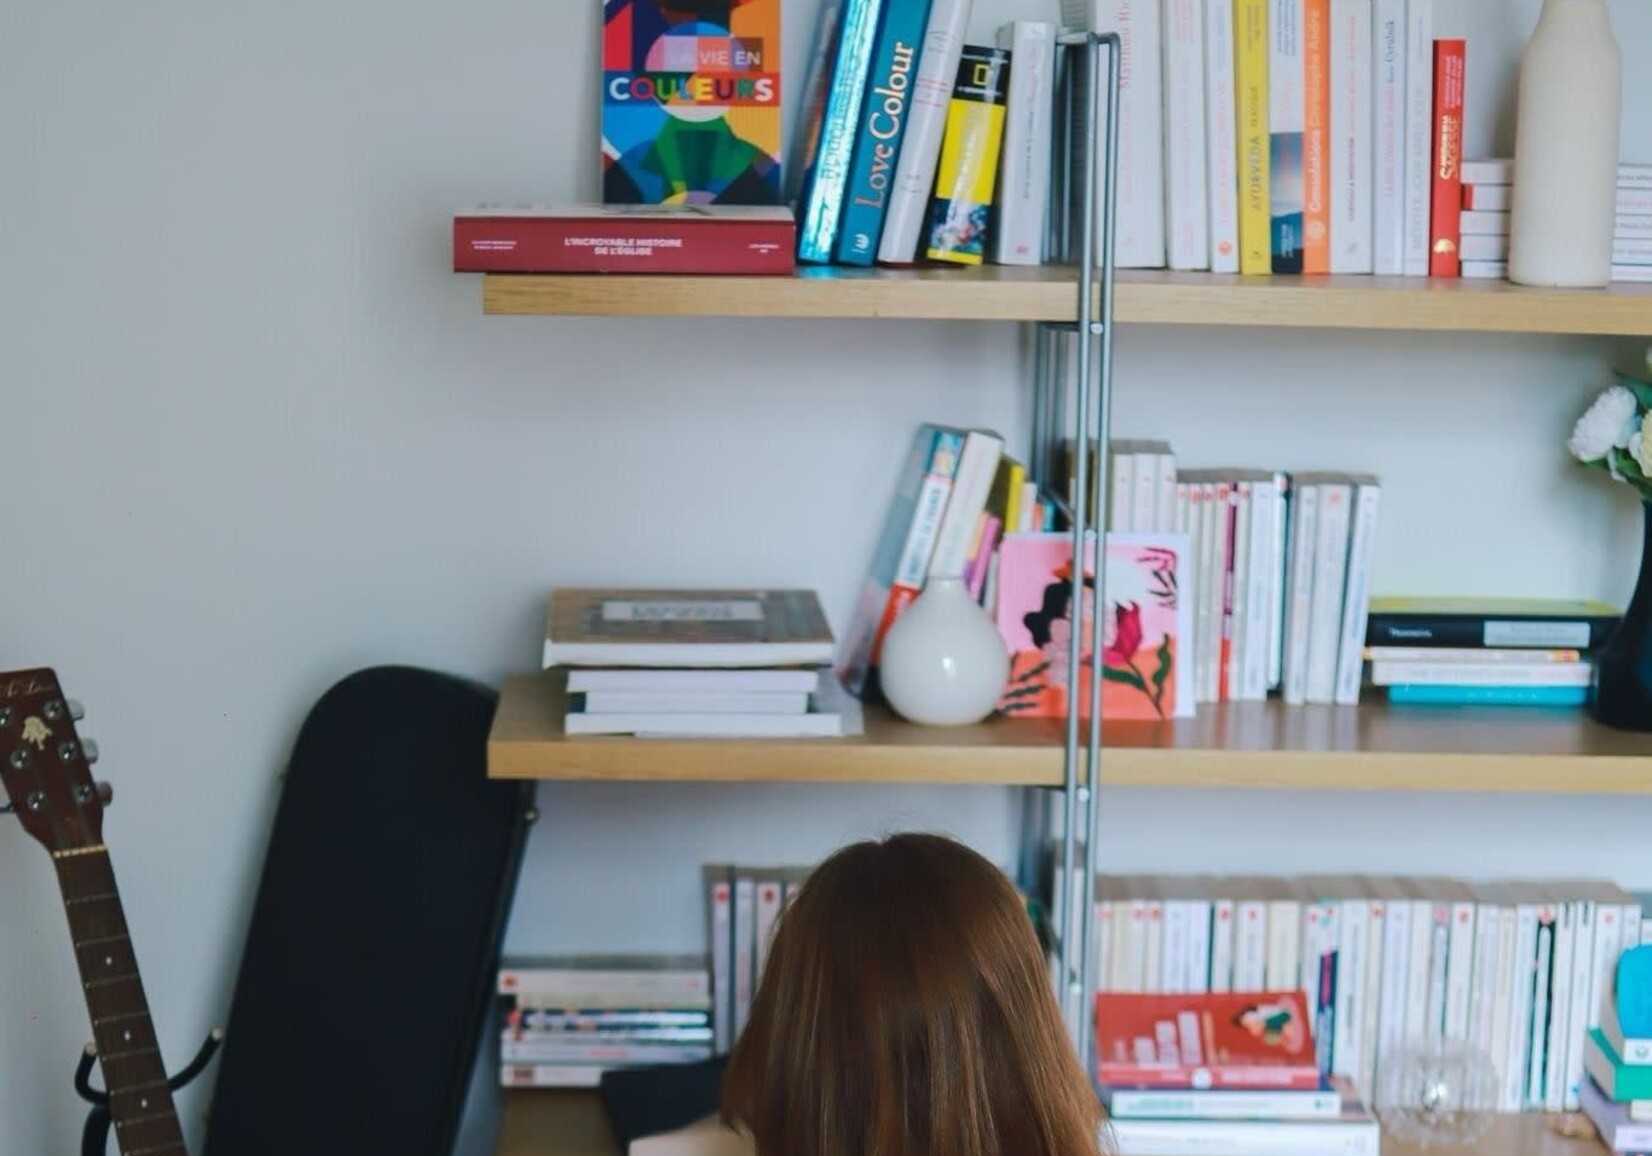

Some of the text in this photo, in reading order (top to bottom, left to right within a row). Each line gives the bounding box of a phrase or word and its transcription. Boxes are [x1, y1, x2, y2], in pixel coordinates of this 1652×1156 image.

[700, 50, 729, 65] VIE
[734, 50, 761, 65] EN
[609, 76, 774, 102] COULEURS
[853, 42, 916, 210] Love Colour
[594, 246, 609, 255] DE
[635, 238, 683, 248] HISTOIRE
